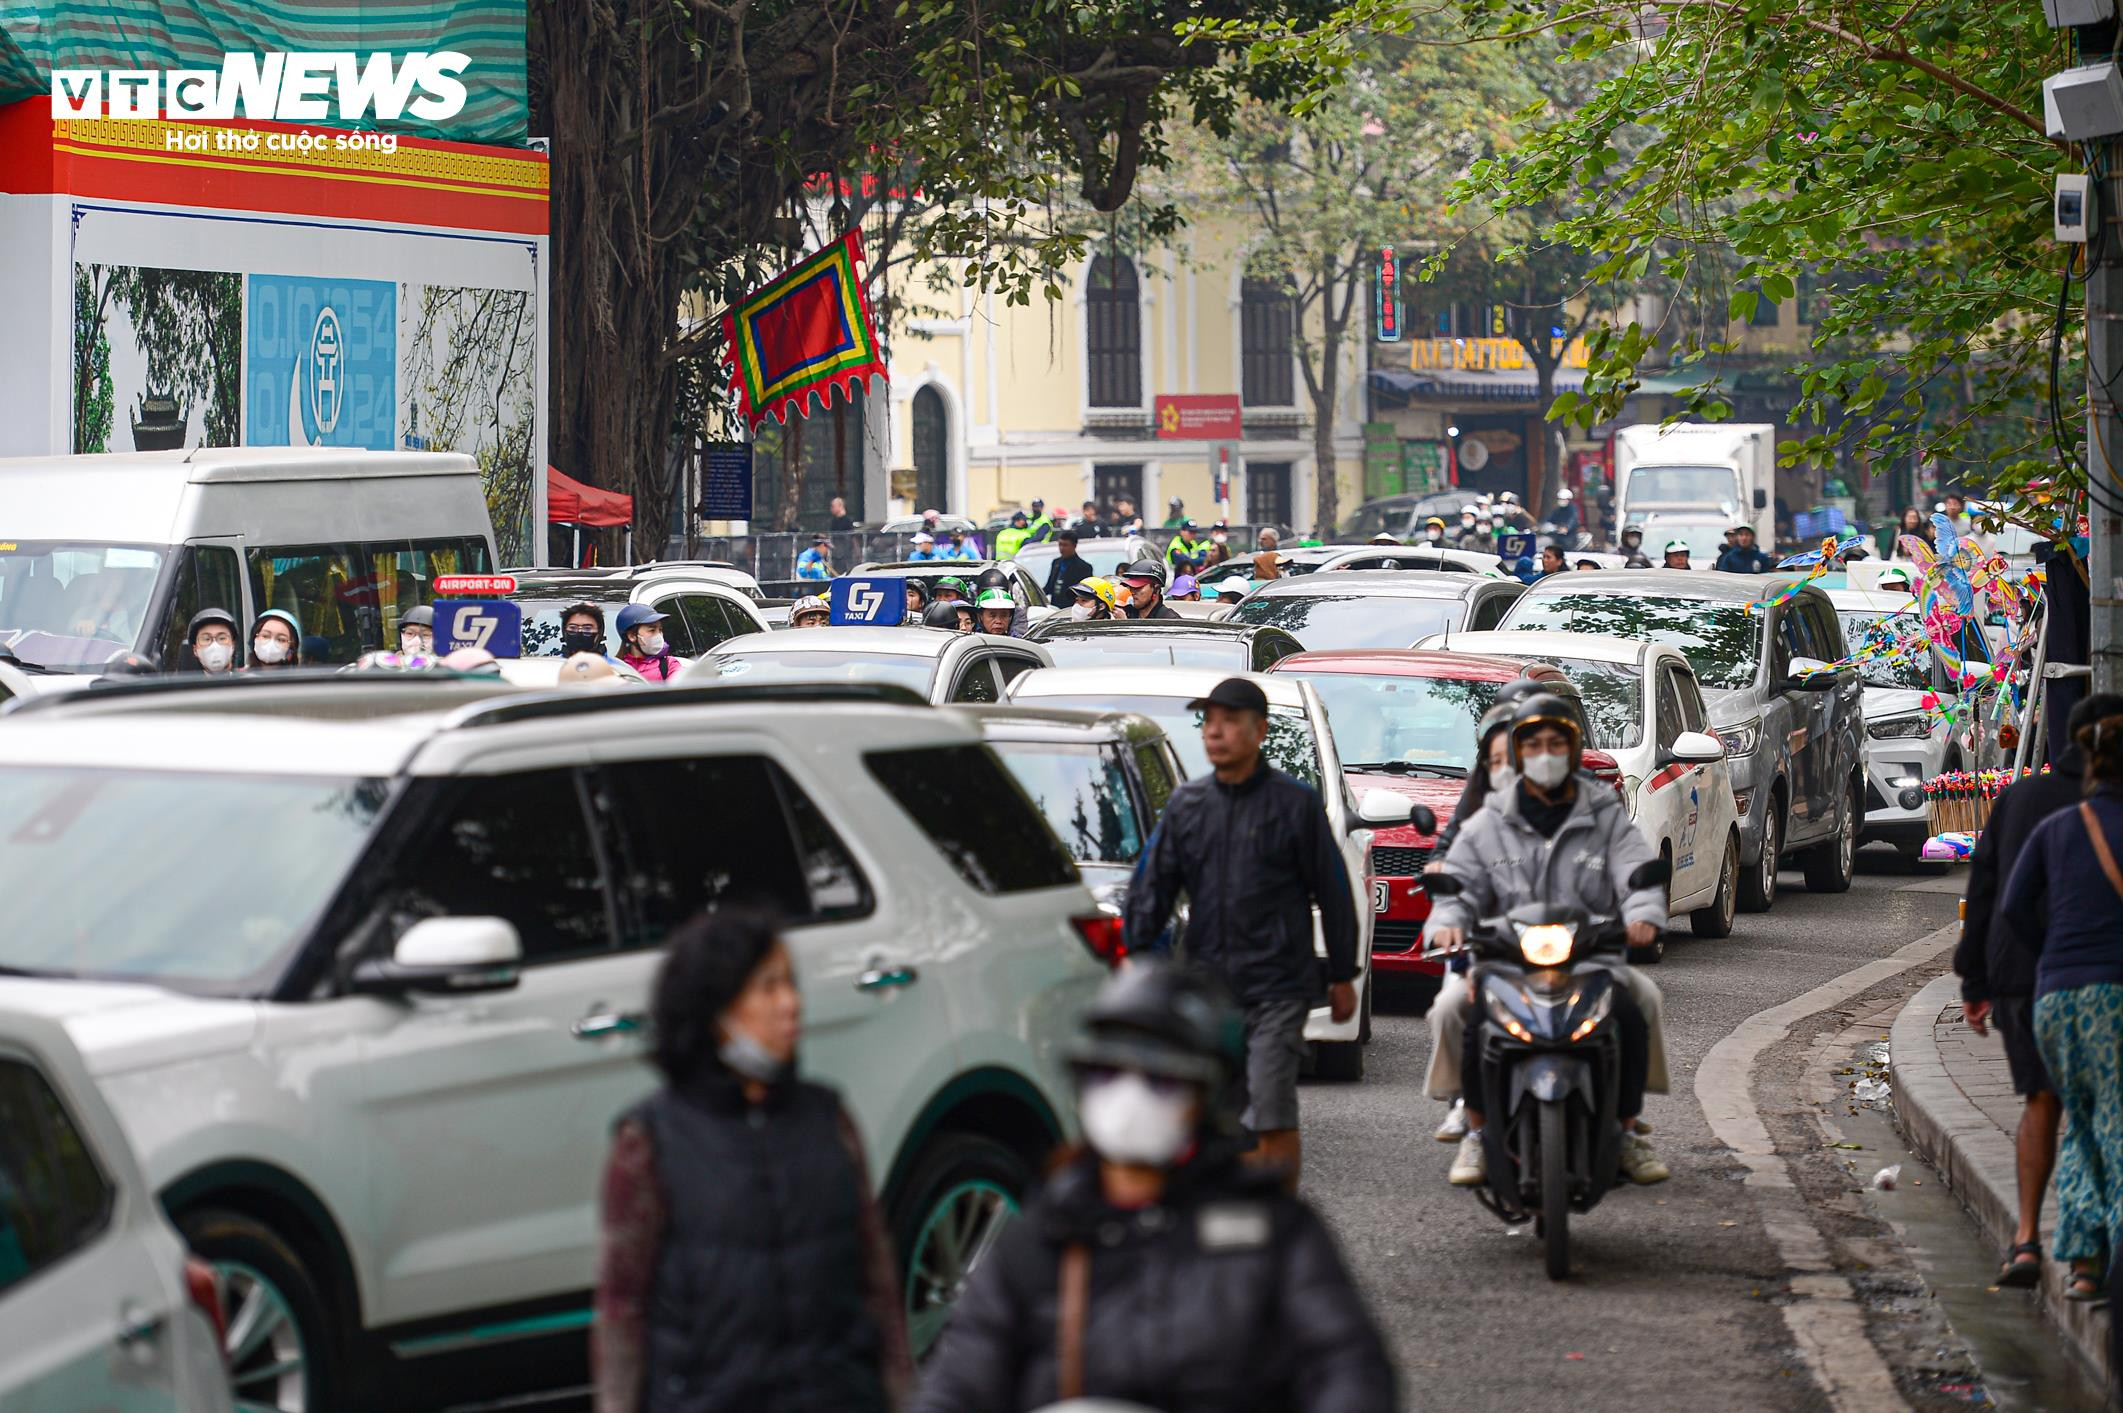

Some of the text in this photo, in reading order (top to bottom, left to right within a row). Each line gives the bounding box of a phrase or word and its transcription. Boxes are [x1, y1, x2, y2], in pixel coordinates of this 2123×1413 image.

[844, 612, 864, 620] TAXI
[848, 582, 884, 621] G7
[452, 606, 498, 650] G7
